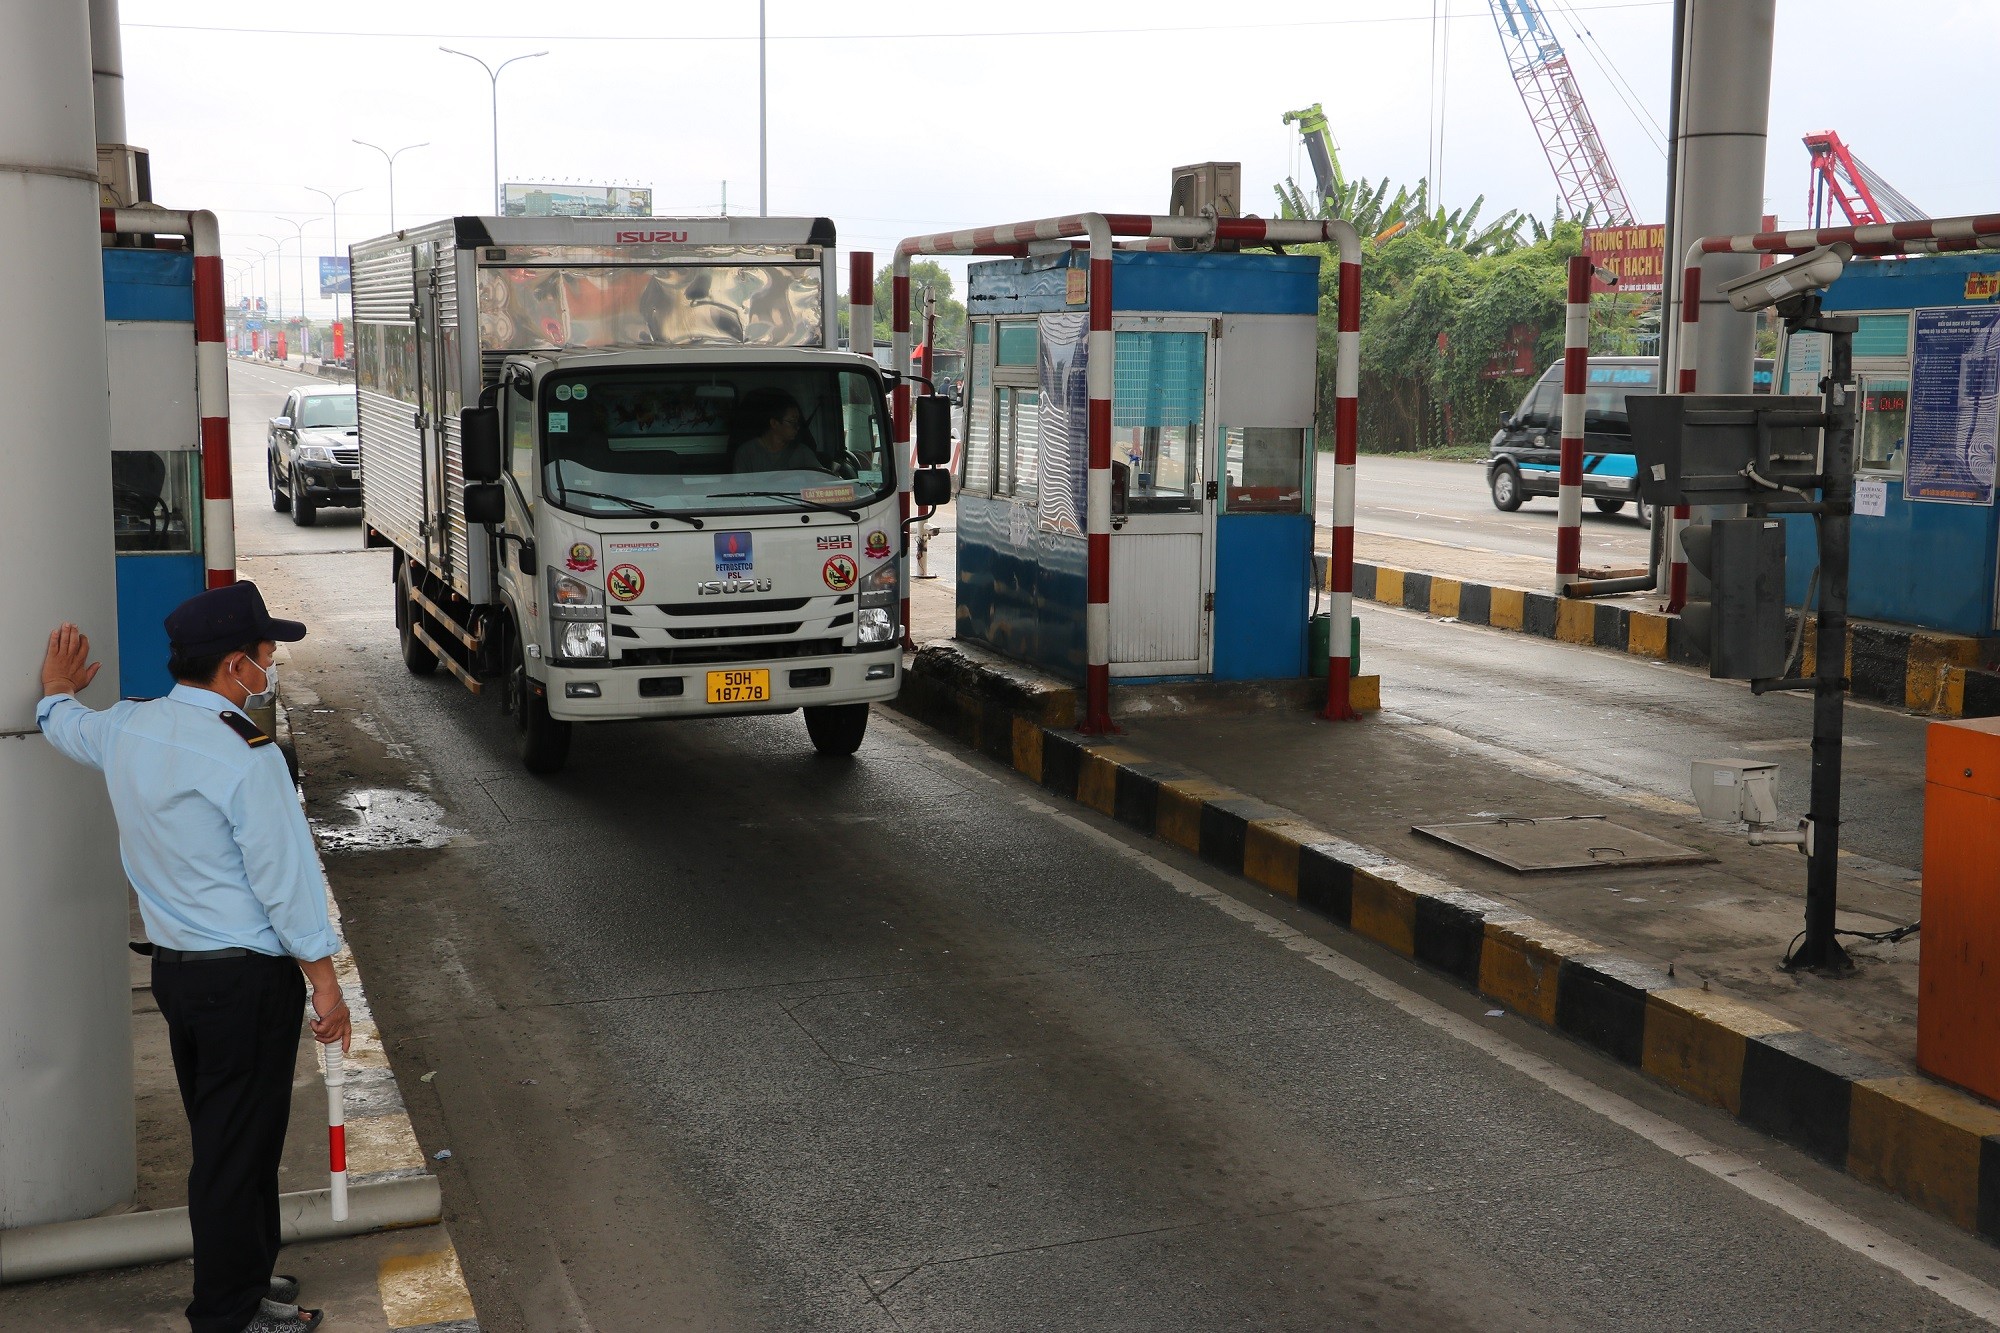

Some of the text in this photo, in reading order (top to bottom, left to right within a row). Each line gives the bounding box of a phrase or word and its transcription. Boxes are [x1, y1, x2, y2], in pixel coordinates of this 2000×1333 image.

[617, 231, 688, 243] ISUZU
[1590, 230, 1623, 251] TRUNG
[1626, 225, 1648, 249] TÂM
[1624, 256, 1653, 281] HẠCH
[816, 535, 852, 543] NQR
[816, 542, 853, 550] 550
[715, 562, 753, 572] PETROSETCO
[727, 571, 742, 579] PSL
[697, 578, 772, 595] ISUZU
[725, 672, 752, 686] 50H
[716, 686, 763, 701] 187.78
